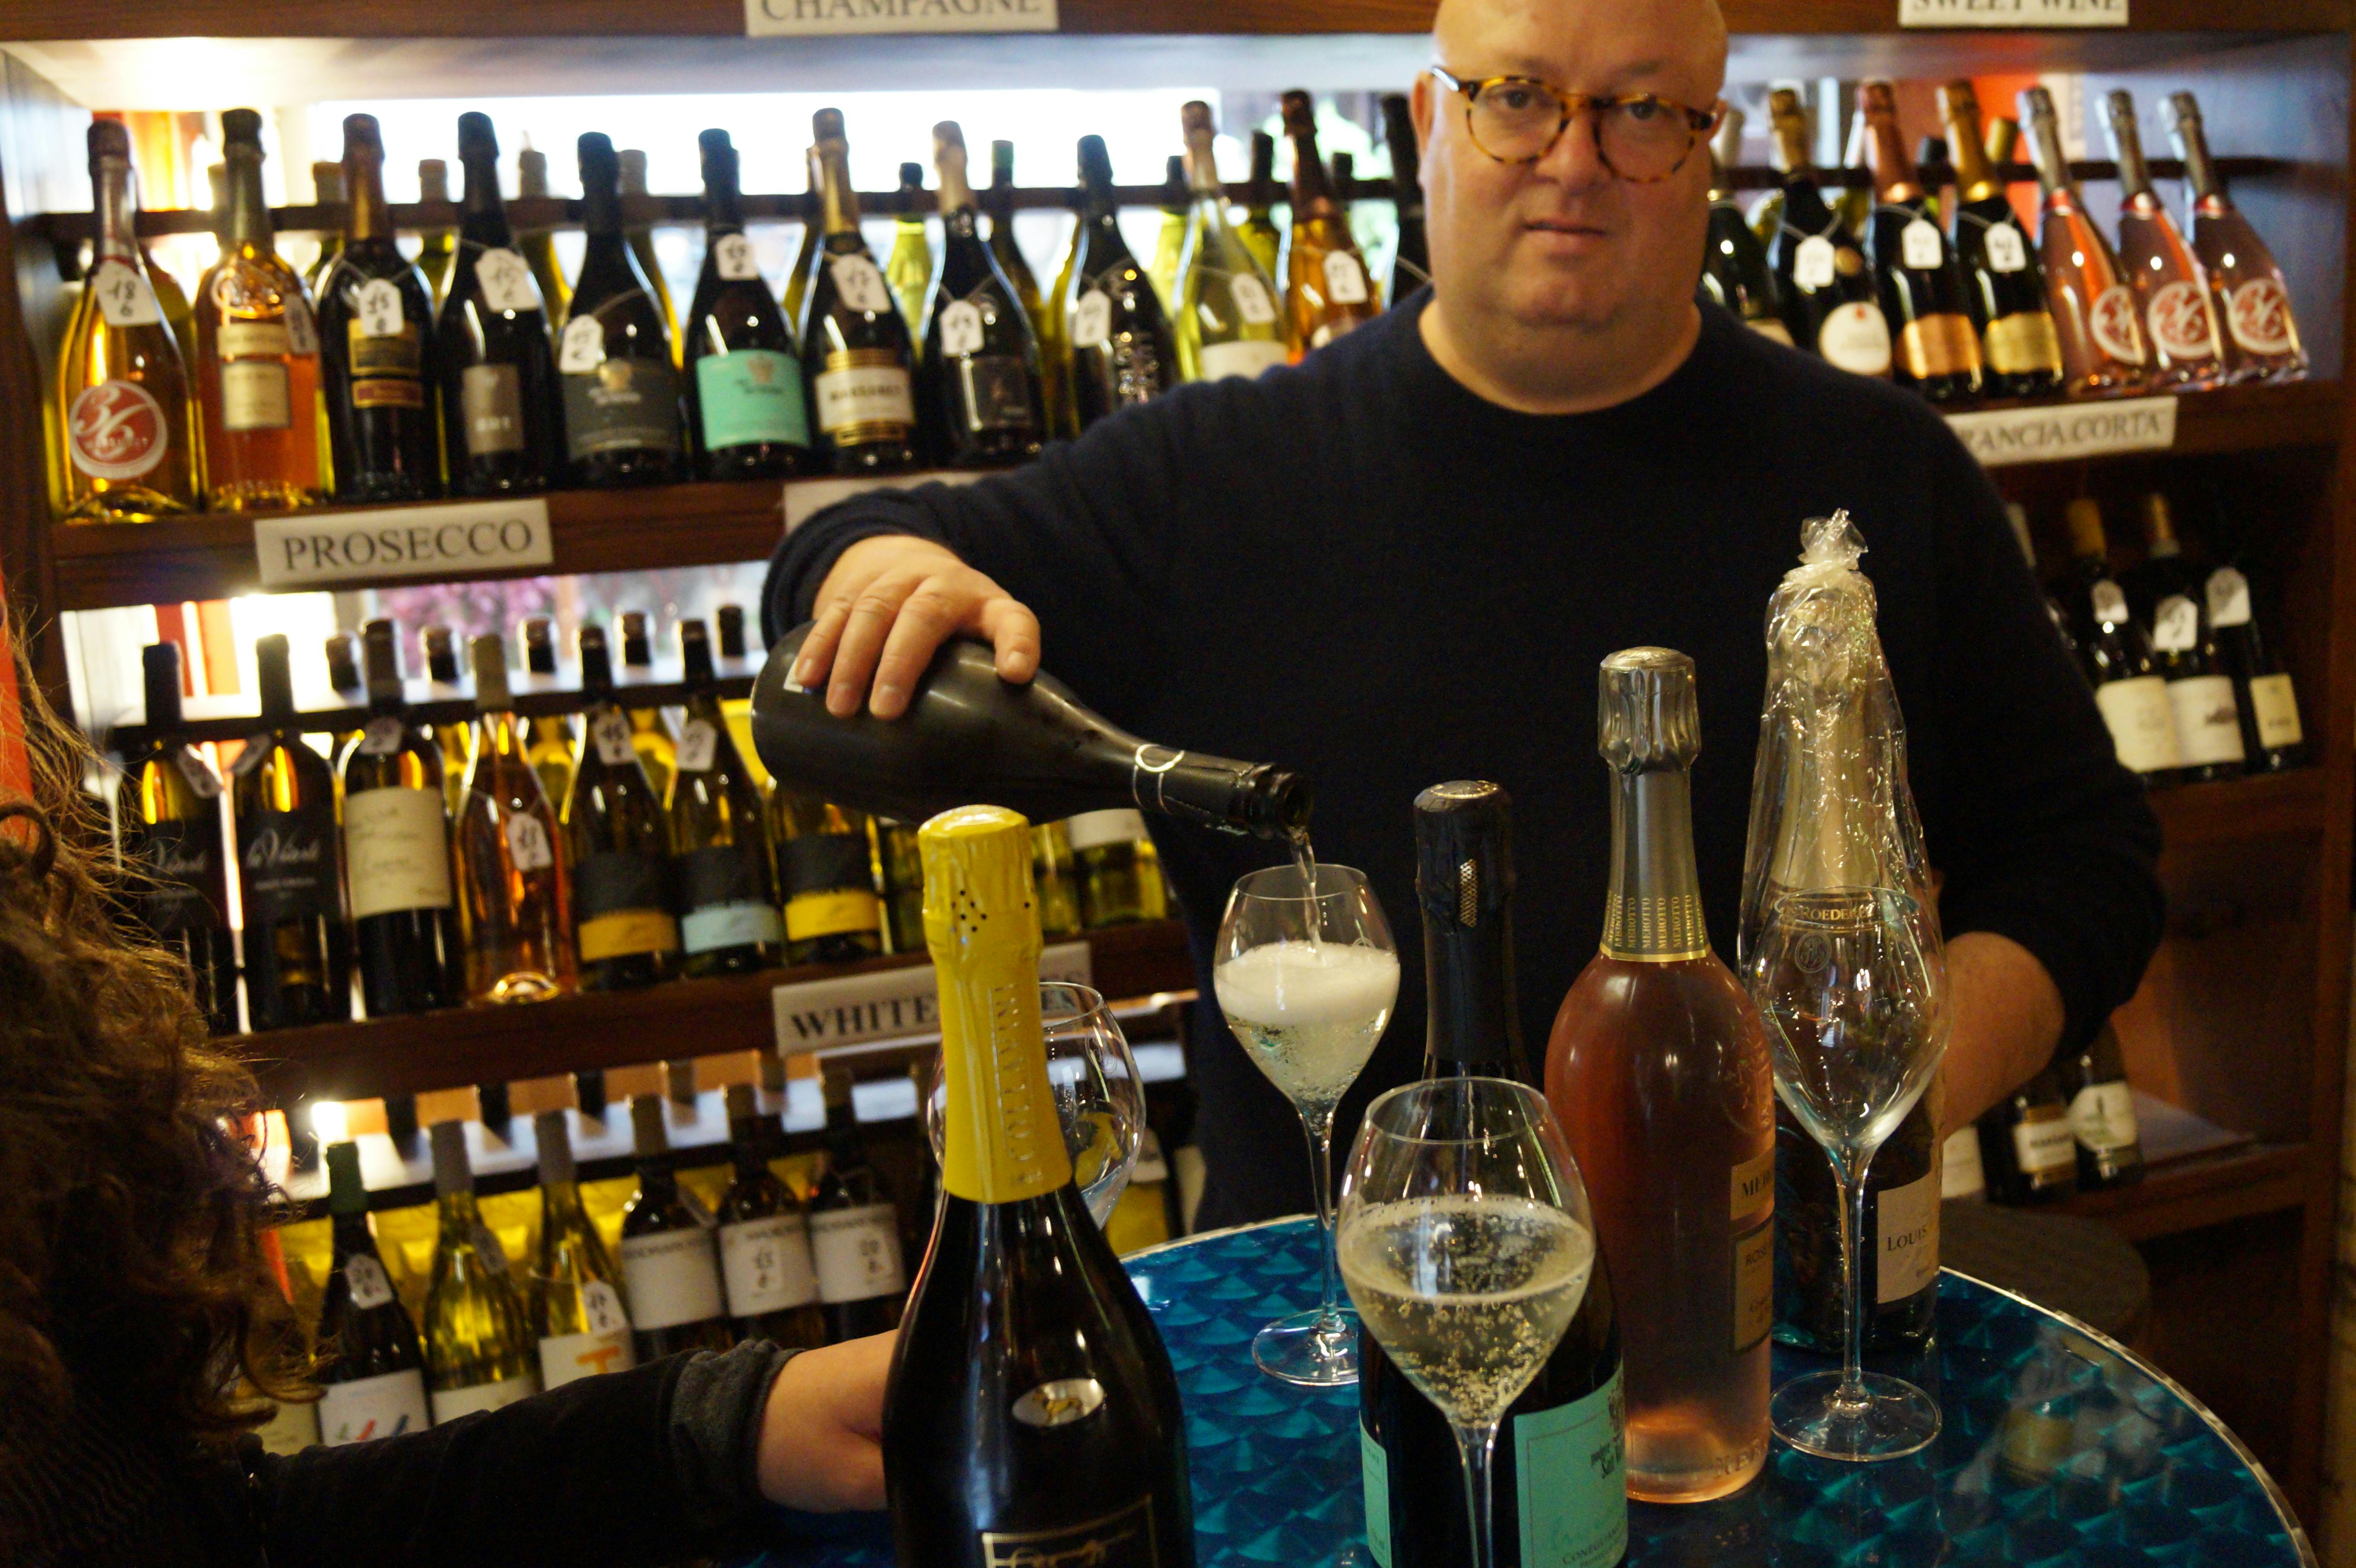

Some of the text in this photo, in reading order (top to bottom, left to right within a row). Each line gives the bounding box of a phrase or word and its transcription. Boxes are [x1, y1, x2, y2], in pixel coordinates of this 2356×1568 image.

[2073, 411, 2160, 441] CORTA
[282, 518, 532, 570] PROSECCO
[790, 995, 938, 1039] WHITE
[1887, 1225, 1926, 1251] LOUIS
